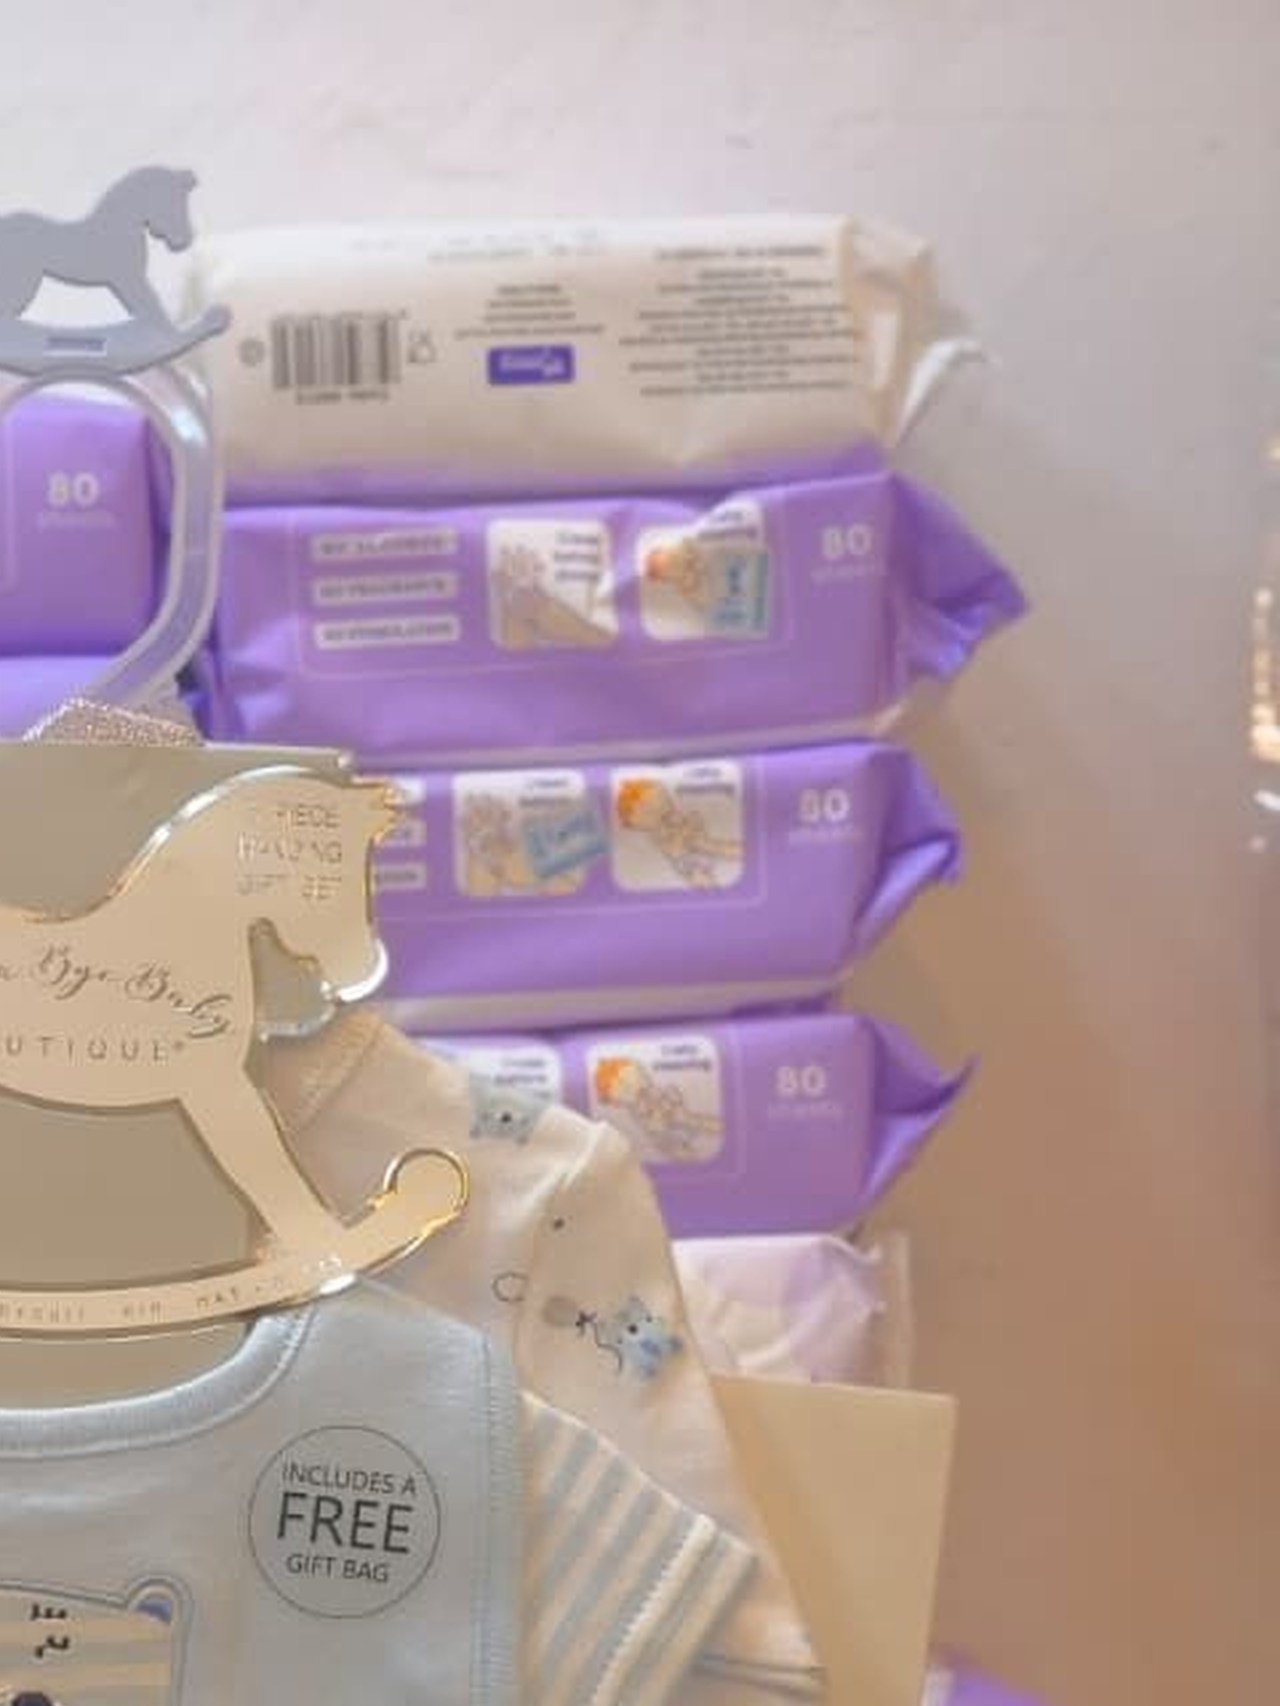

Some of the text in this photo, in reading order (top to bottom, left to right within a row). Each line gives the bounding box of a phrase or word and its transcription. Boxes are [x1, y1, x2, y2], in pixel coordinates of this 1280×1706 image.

[47, 472, 101, 508] 80
[820, 522, 874, 562] 80
[798, 788, 851, 824] 80
[775, 1064, 829, 1098] 80
[281, 1461, 418, 1496] INCLUDES A
[276, 1490, 415, 1556] FREE
[285, 1552, 390, 1584] GIFT BAG
